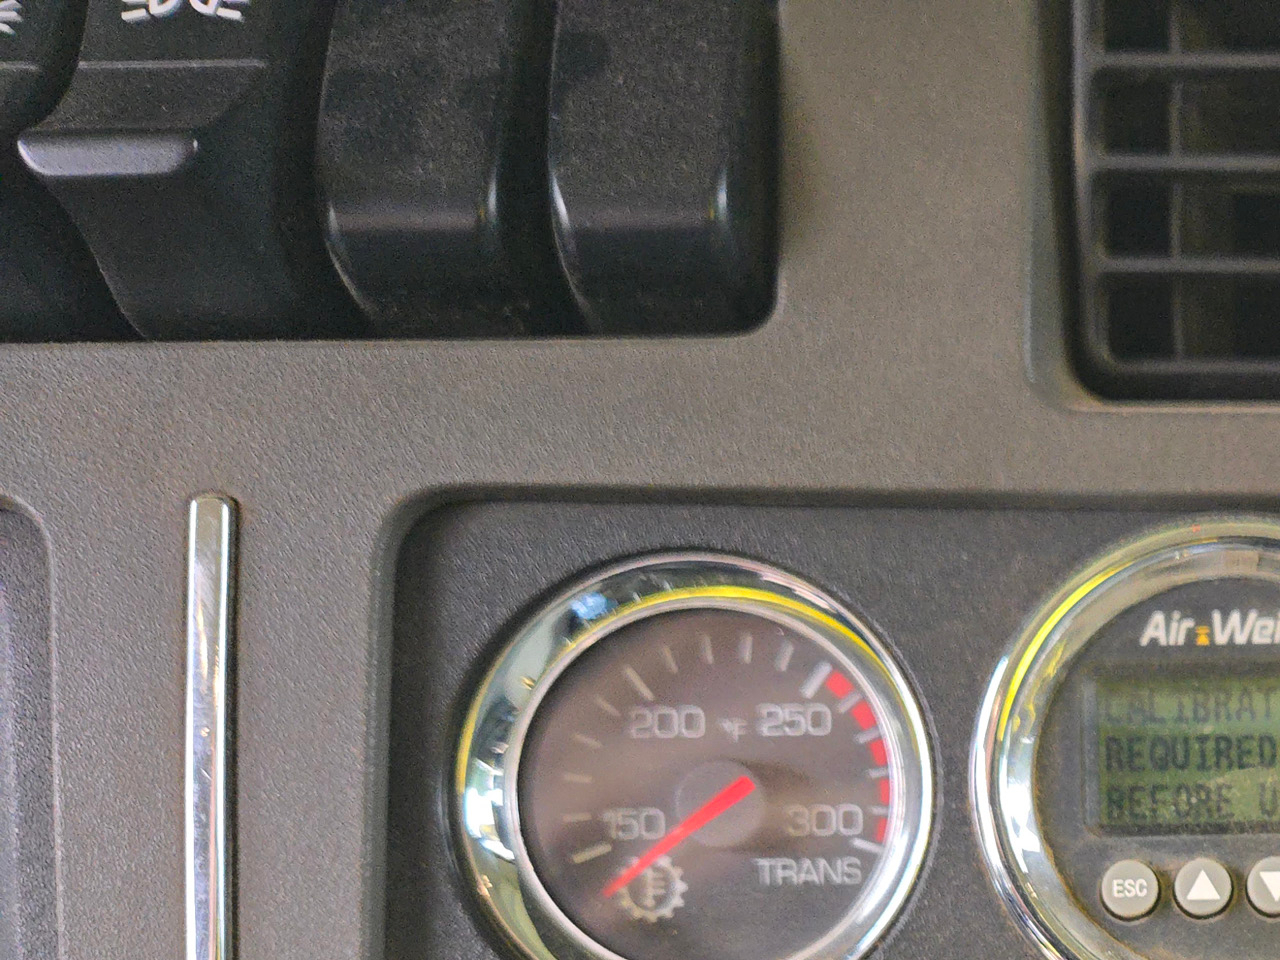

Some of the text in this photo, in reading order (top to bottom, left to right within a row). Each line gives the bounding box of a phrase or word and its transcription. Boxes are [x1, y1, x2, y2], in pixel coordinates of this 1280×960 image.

[628, 704, 706, 739] 200
[754, 703, 833, 737] 250
[1105, 733, 1278, 772] REQUIRED
[1106, 783, 1234, 820] BEFORE
[604, 807, 666, 840] 150
[786, 803, 864, 836] 300
[756, 857, 863, 887] TRANS
[1112, 879, 1148, 898] ESC
